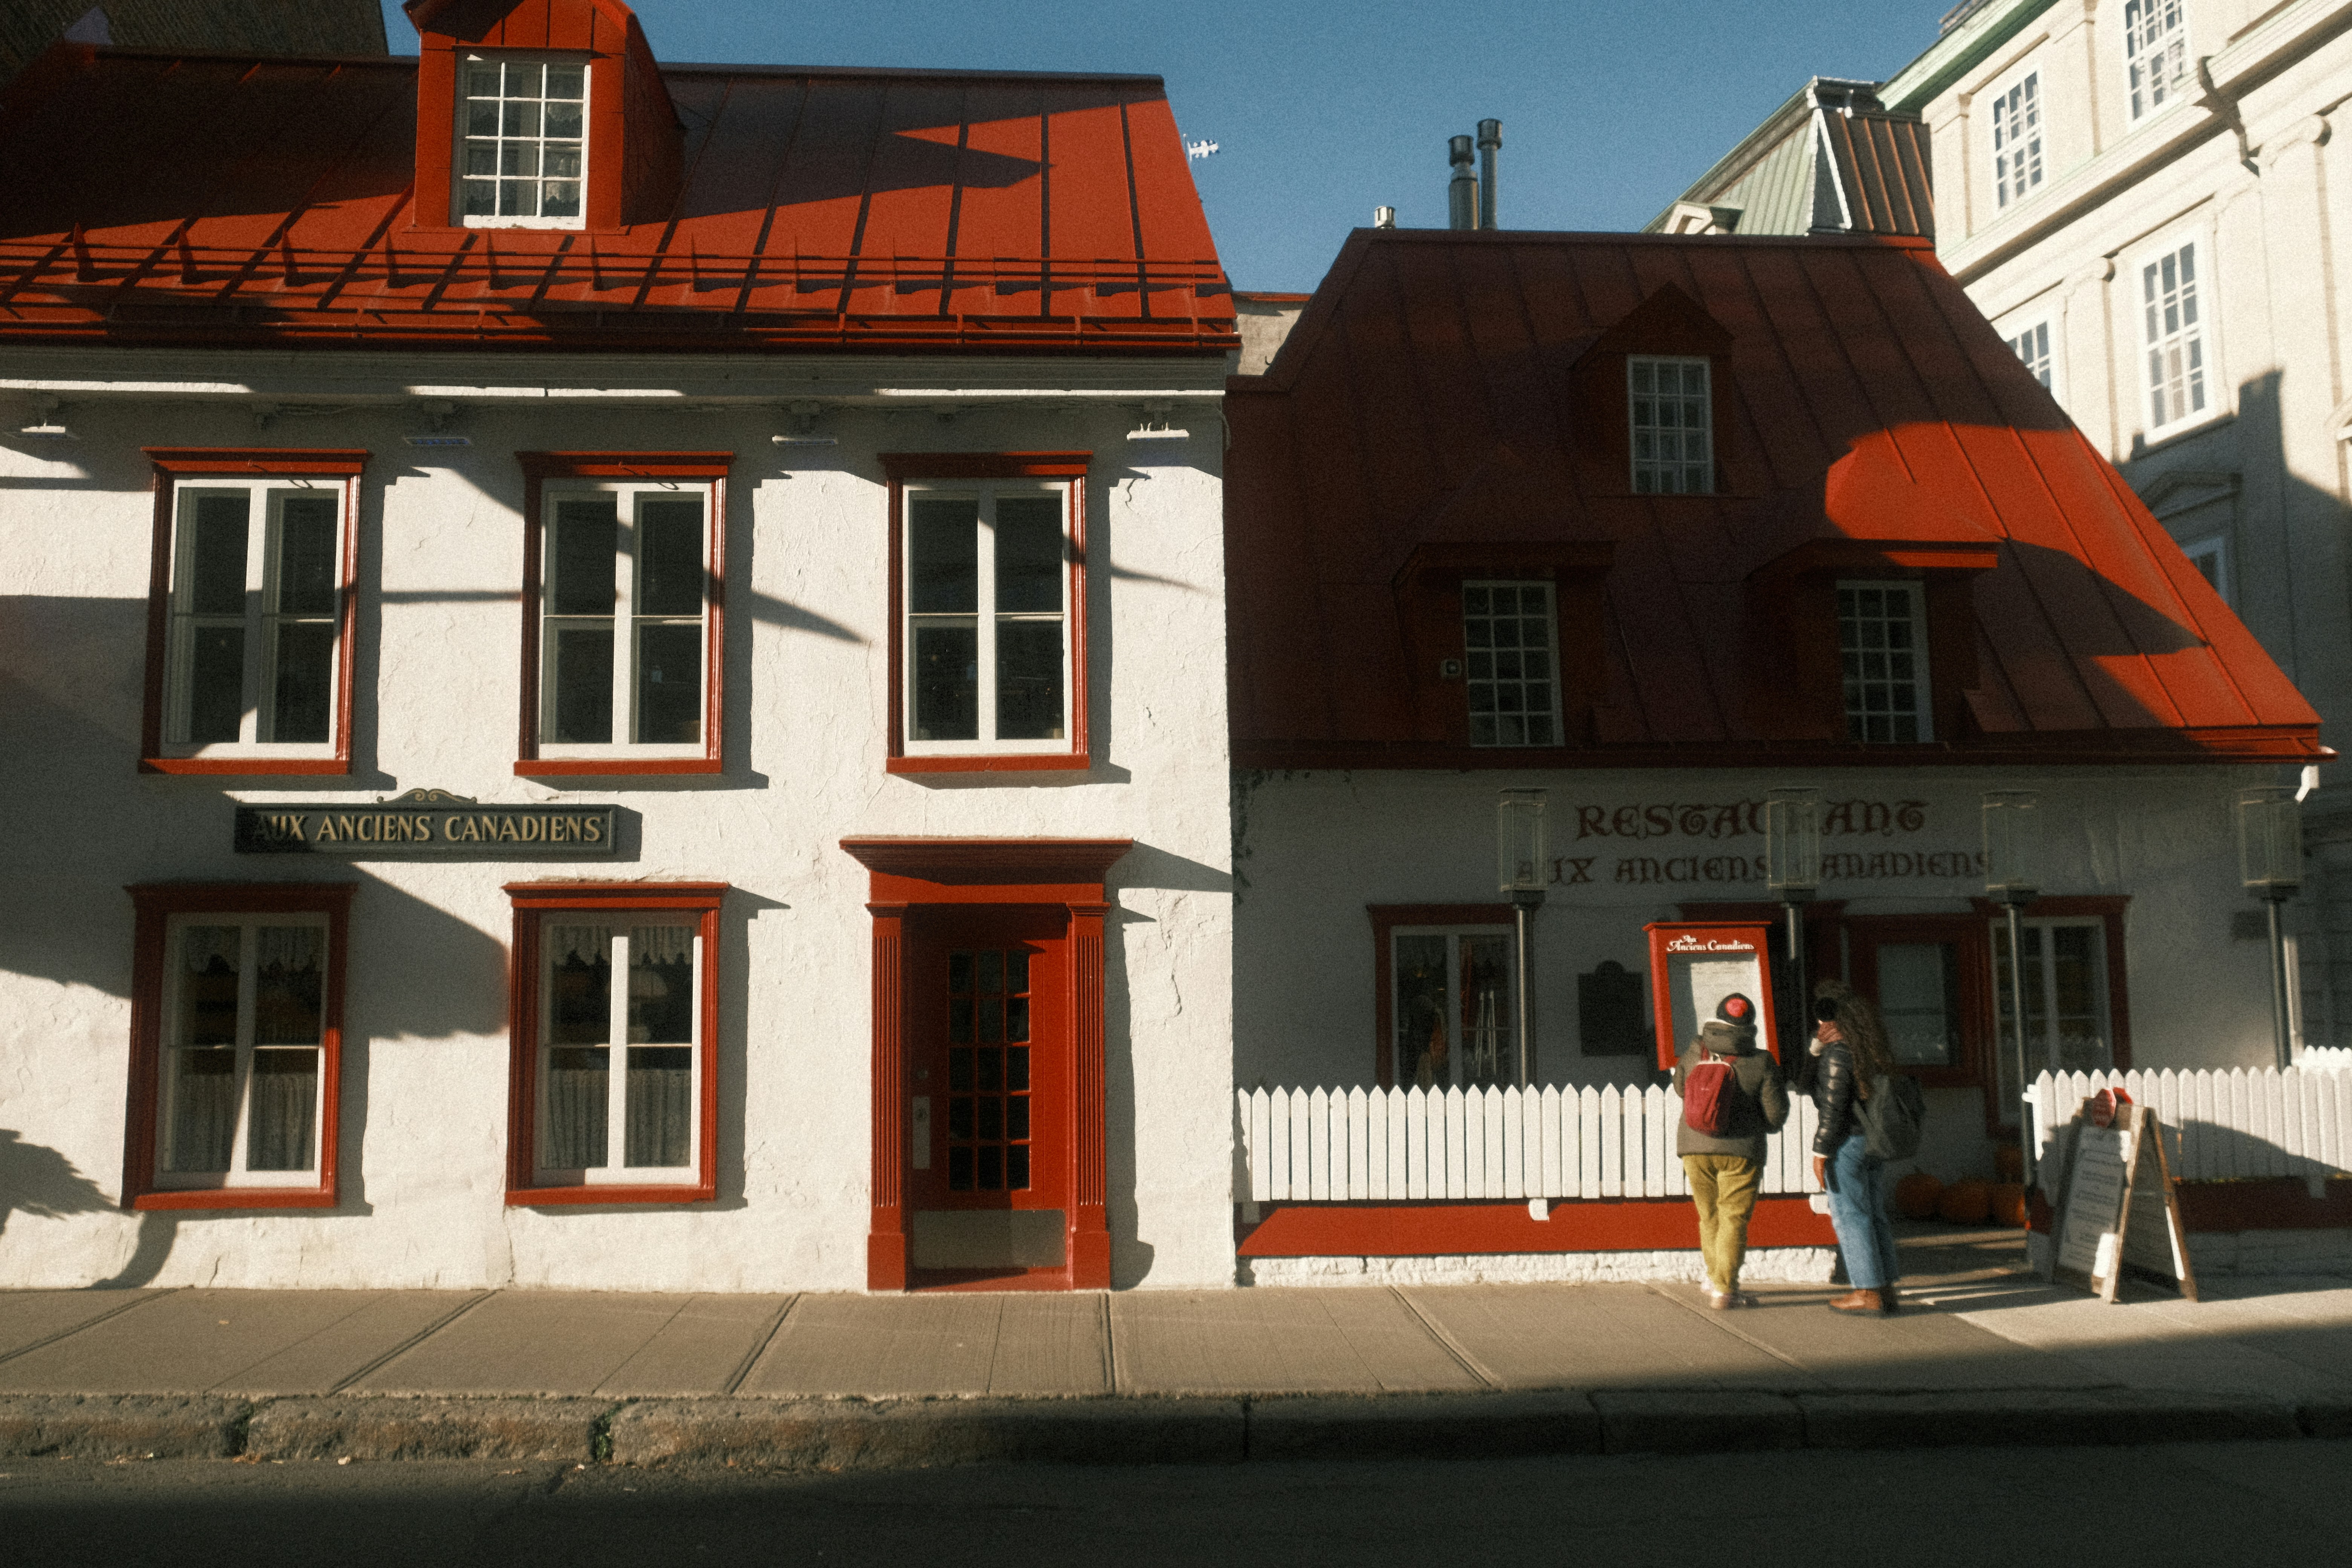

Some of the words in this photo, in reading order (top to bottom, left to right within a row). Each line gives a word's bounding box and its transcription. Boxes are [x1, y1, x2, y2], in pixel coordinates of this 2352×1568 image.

[252, 815, 305, 841] AUX
[316, 815, 431, 842] ANCIENS
[444, 815, 601, 842] CANADIENS
[1615, 855, 1769, 884] ANCIENS
[1795, 850, 1994, 880] ANADIENS
[1666, 939, 1707, 952] Anciens
[1707, 939, 1755, 951] Canadiens
[1683, 934, 1697, 943] Aux
